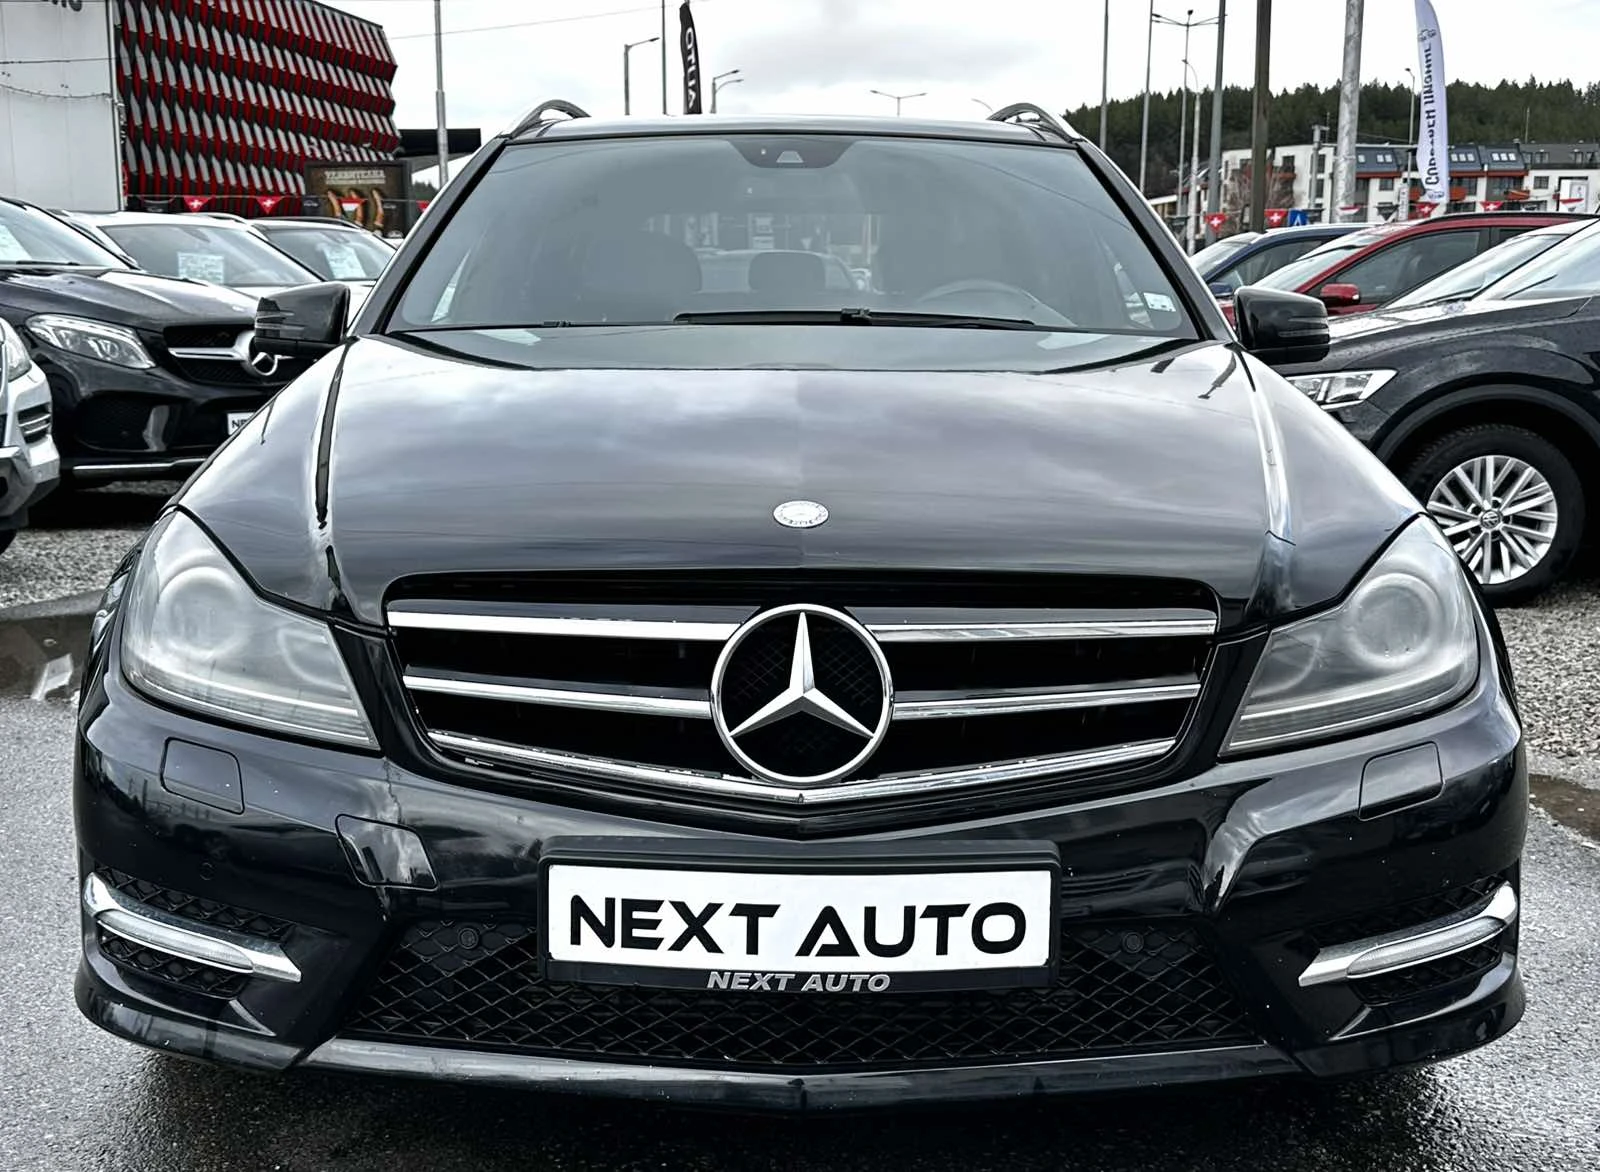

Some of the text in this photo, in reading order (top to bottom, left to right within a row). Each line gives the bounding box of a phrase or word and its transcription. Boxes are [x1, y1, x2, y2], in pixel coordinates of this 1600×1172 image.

[570, 894, 1027, 958] NEXT AUTO
[706, 971, 891, 992] NEXT AUTO
